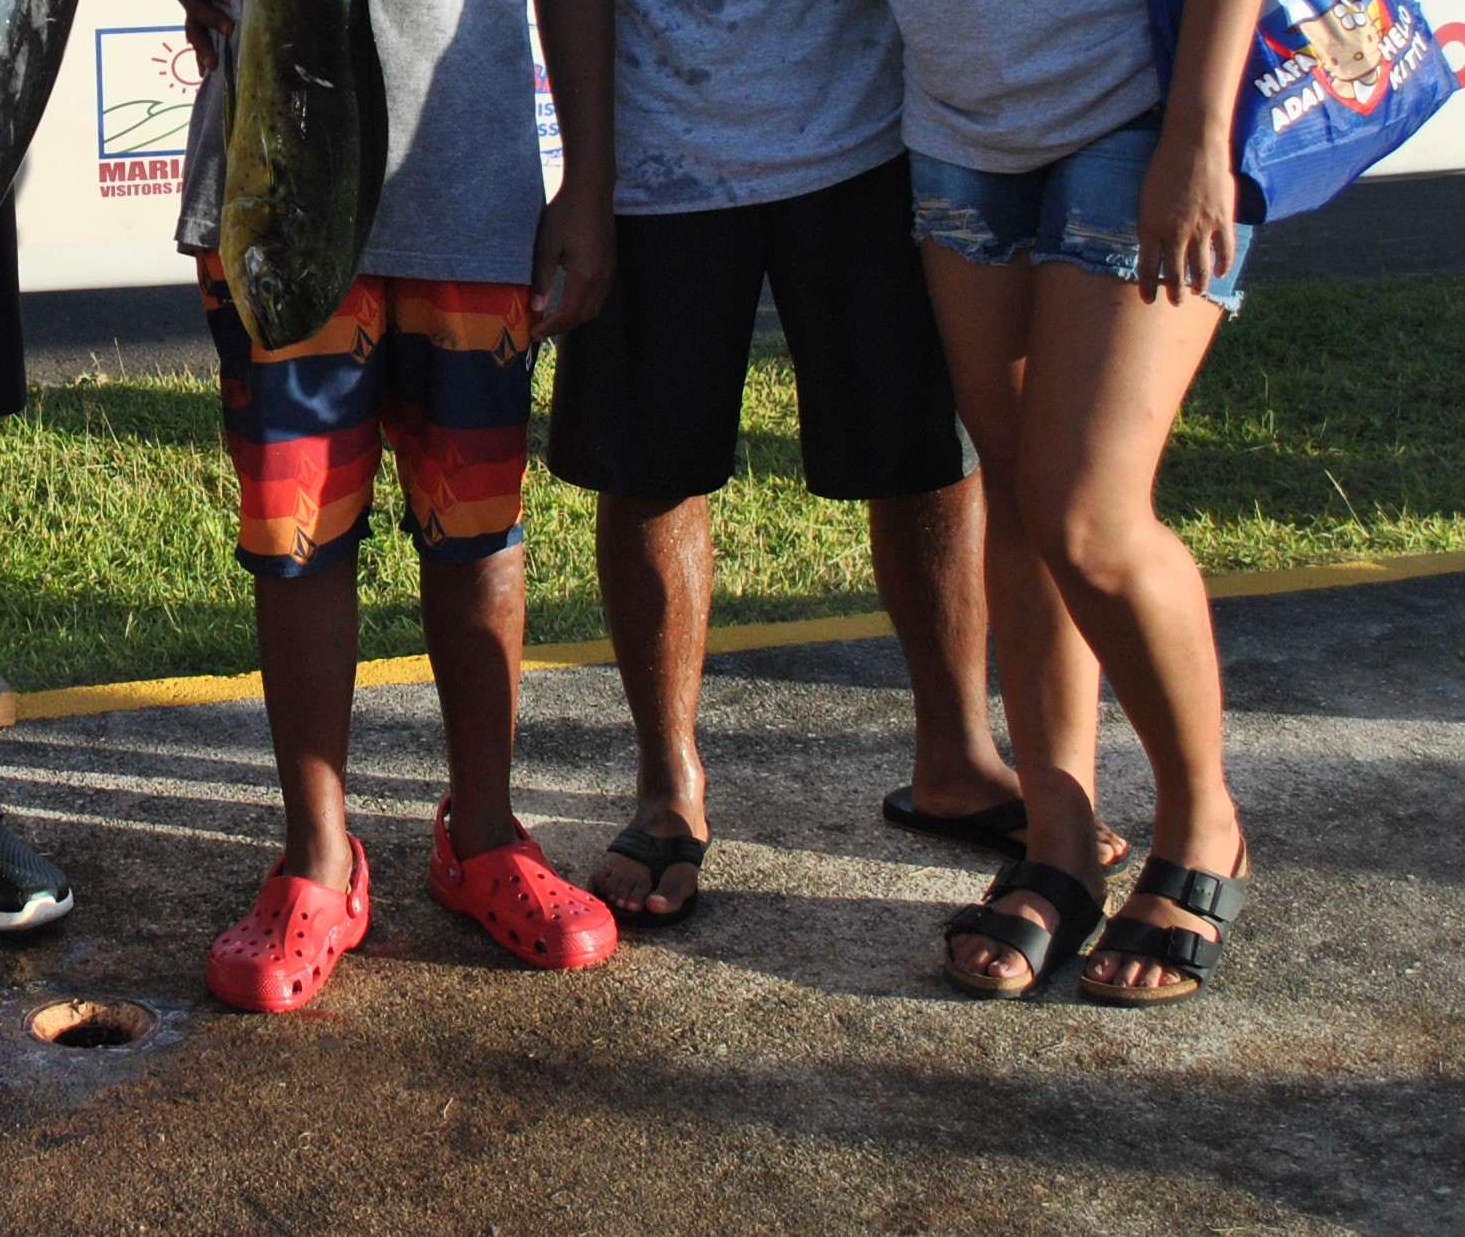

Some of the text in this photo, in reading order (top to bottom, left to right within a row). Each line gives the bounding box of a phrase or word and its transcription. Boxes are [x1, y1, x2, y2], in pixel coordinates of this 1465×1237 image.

[1271, 80, 1325, 132] ADAI
[98, 158, 182, 183] MARI
[99, 182, 173, 198] VISITORS
